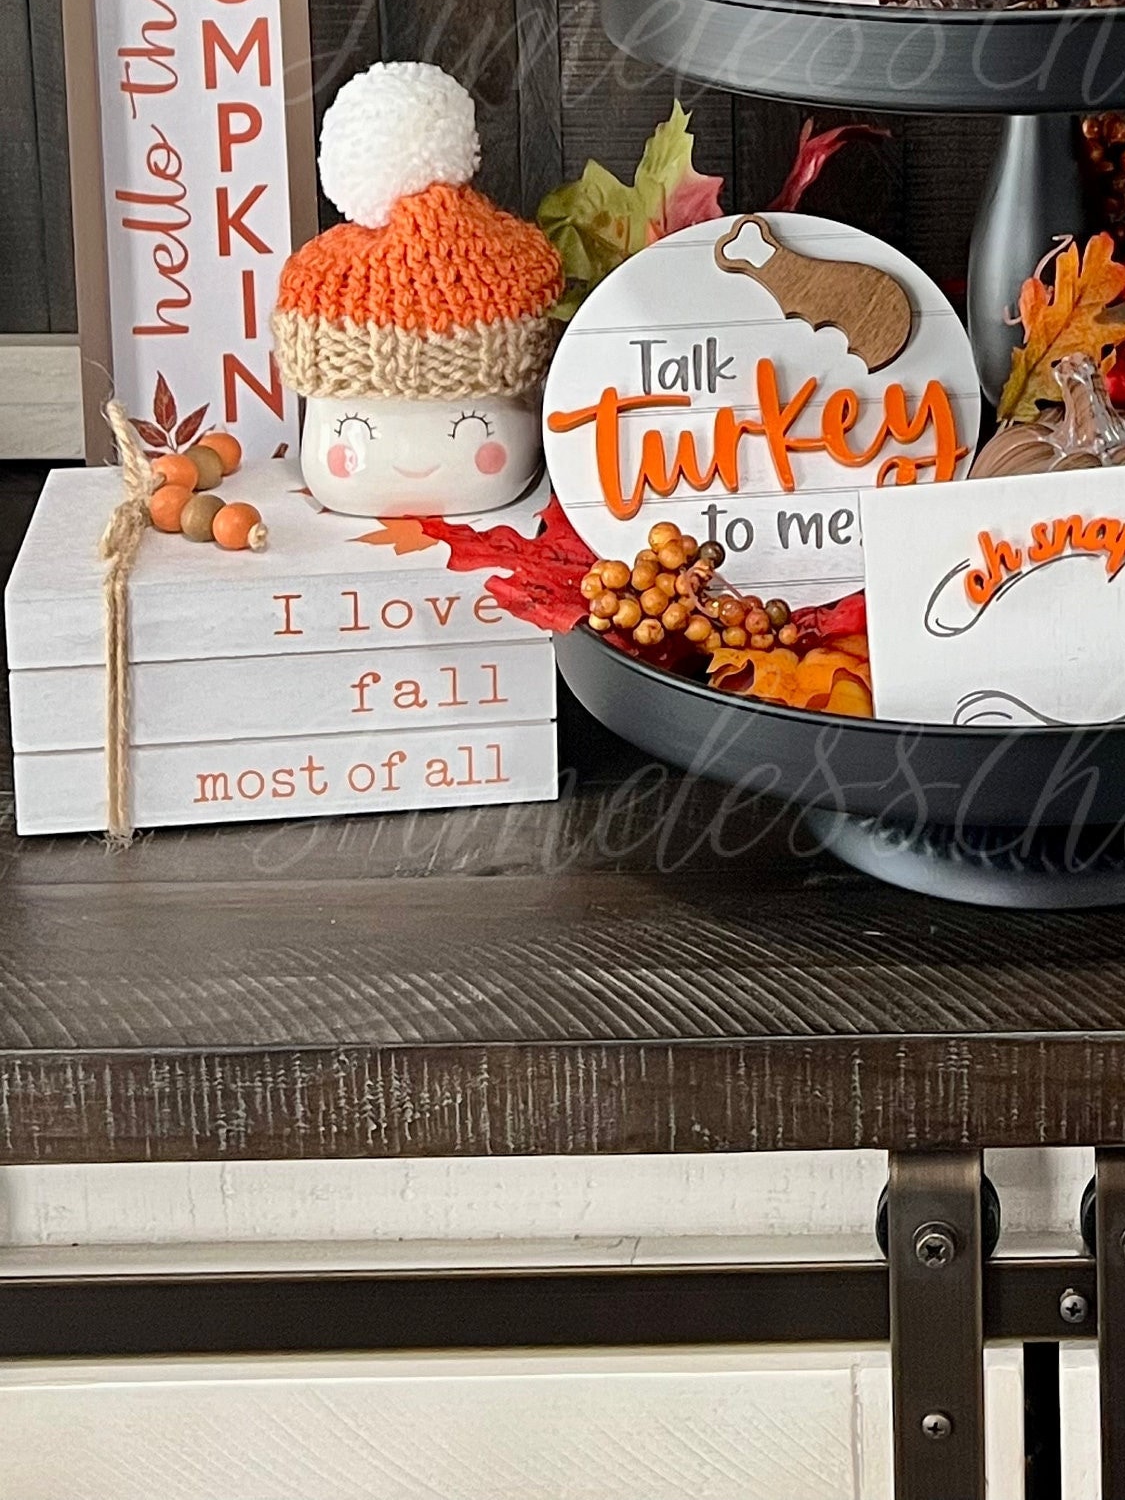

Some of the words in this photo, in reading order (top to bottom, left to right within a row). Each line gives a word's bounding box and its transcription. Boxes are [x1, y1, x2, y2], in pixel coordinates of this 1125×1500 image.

[115, 124, 192, 337] hello
[629, 337, 737, 395] Talk
[701, 503, 754, 552] to
[777, 508, 863, 549] me
[965, 531, 1022, 604] oh
[273, 594, 303, 636] I
[339, 590, 504, 633] love
[350, 665, 509, 714] fall
[194, 754, 329, 804] most
[348, 750, 407, 793] of
[425, 744, 511, 788] all
